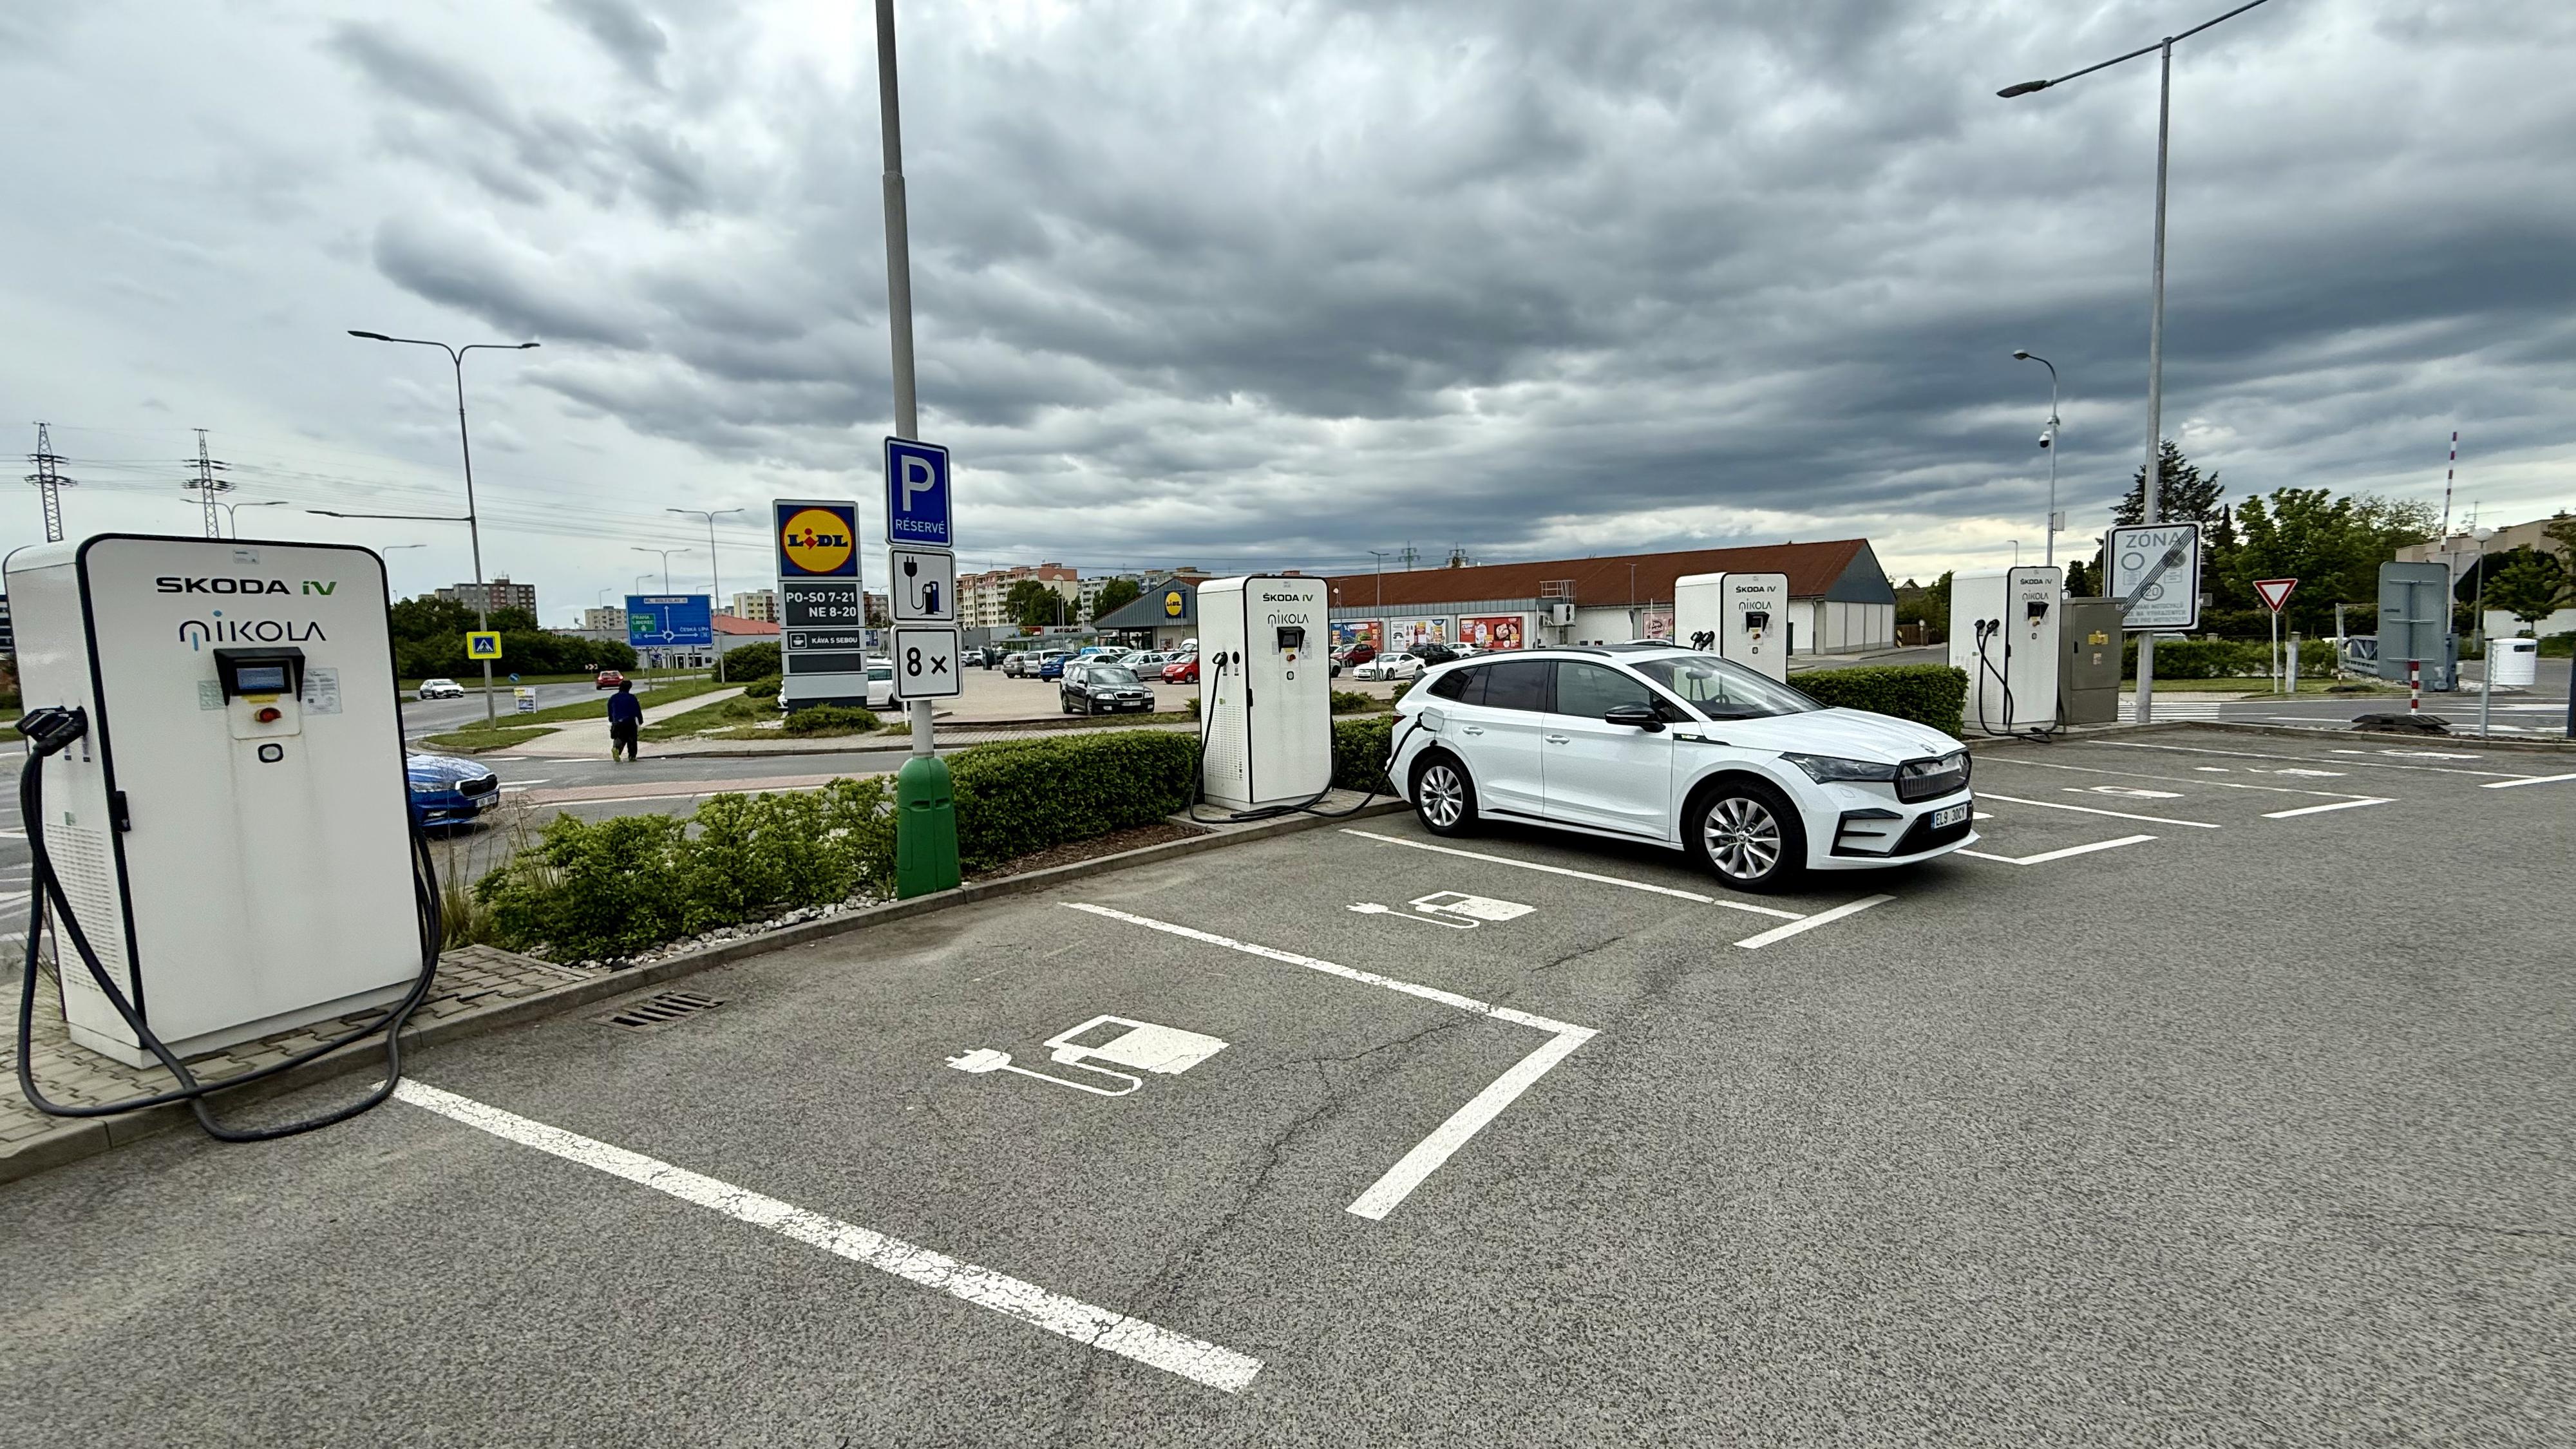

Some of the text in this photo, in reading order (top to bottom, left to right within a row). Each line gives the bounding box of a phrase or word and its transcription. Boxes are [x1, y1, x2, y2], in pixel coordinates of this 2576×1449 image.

[901, 455, 935, 512] P
[895, 517, 945, 535] RÉSERVÉ
[2126, 531, 2182, 548] ZÓNA
[786, 592, 855, 603] PO-SO 7-21
[1263, 592, 1300, 601] ŠKODA
[2145, 587, 2159, 596] 20
[809, 607, 857, 617] NE 8-20
[907, 647, 922, 677] 8
